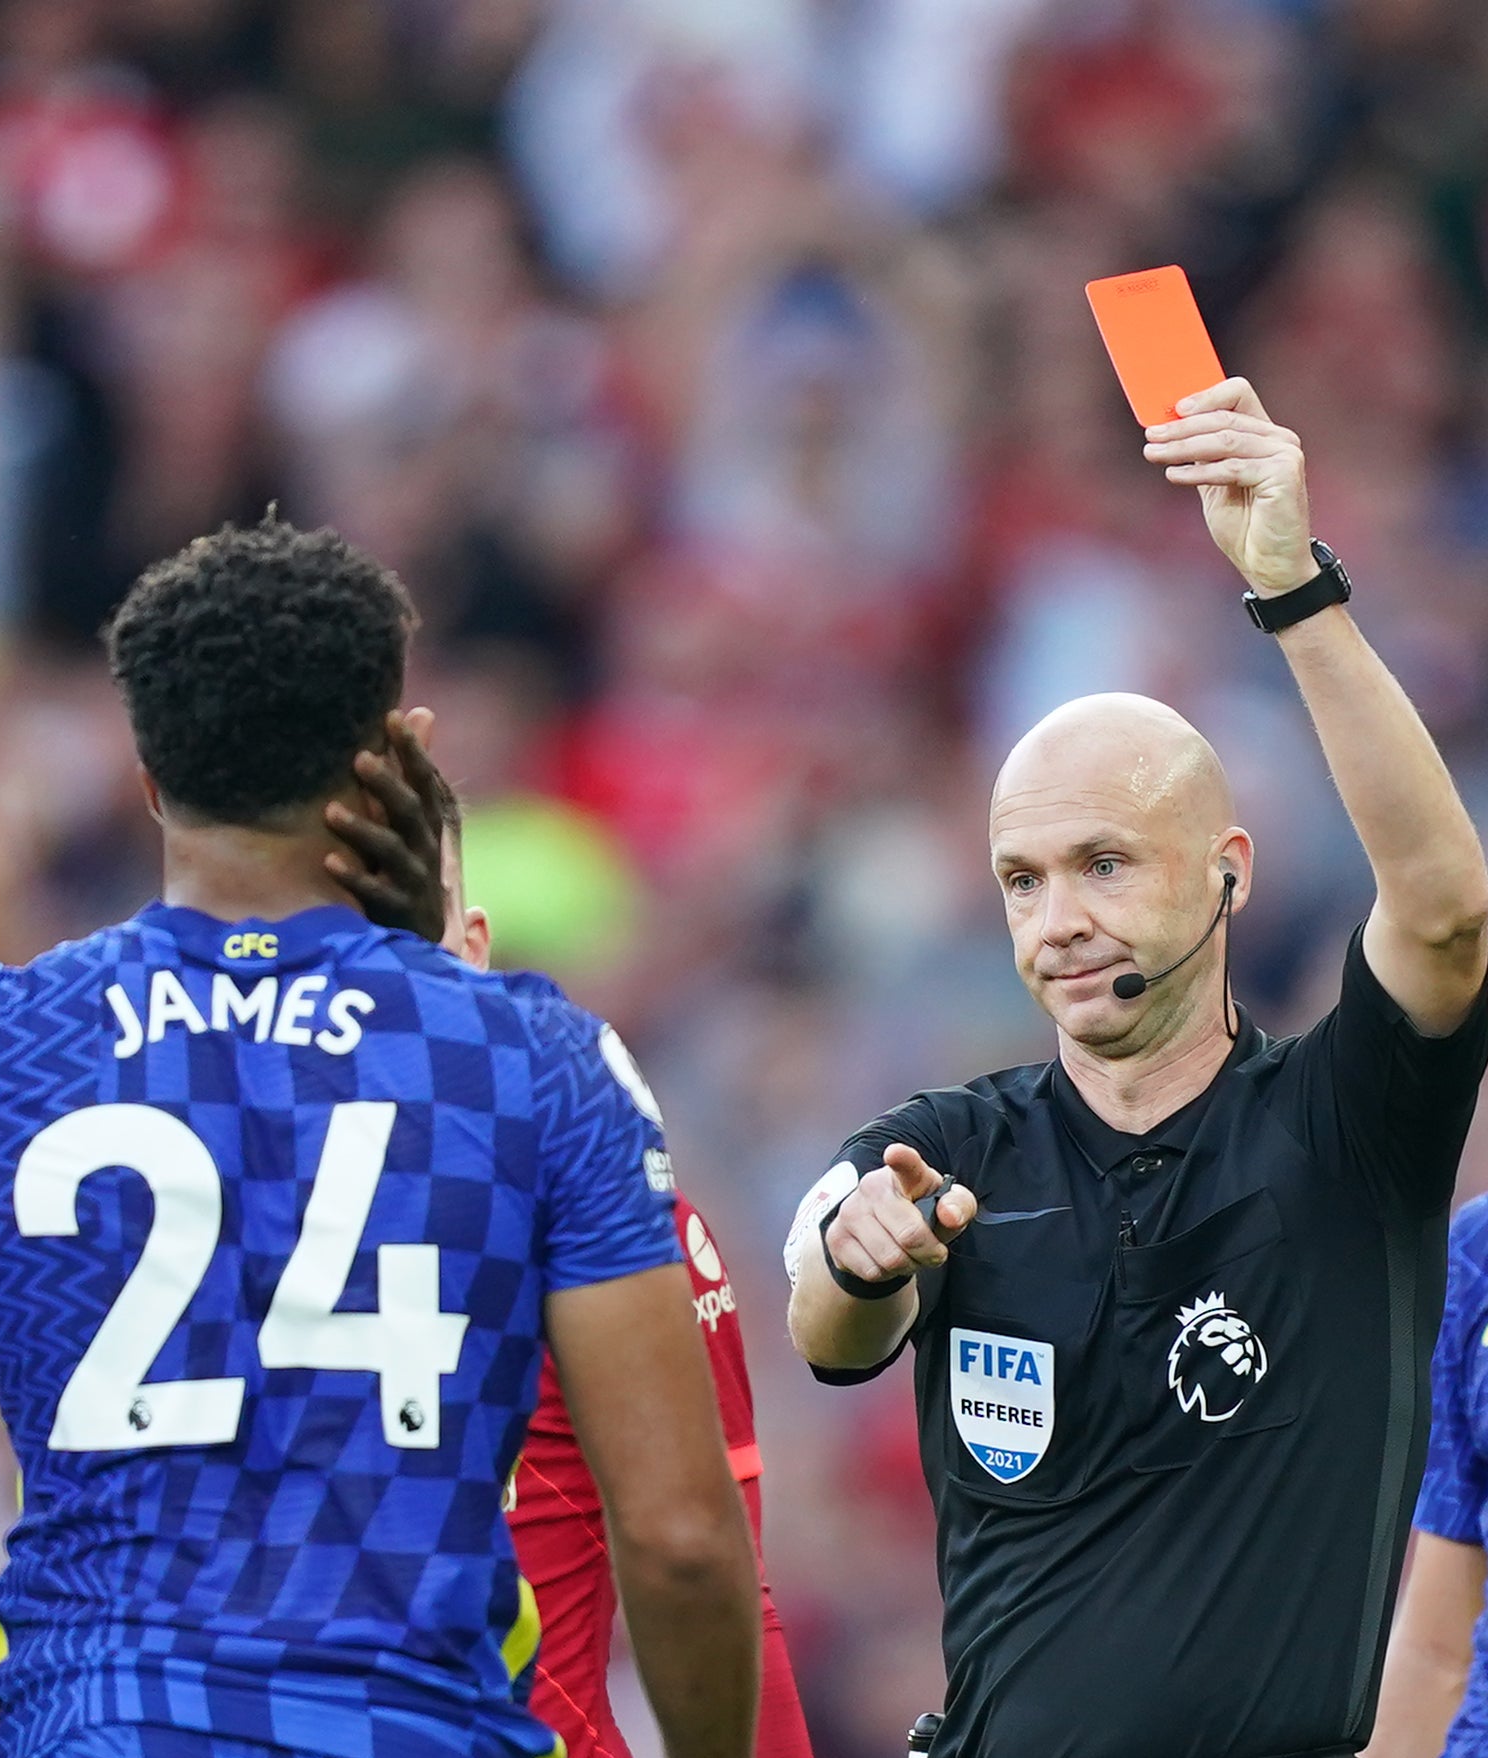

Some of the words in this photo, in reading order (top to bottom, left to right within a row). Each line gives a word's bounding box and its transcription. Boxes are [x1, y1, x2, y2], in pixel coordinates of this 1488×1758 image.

[224, 932, 279, 959] CFC
[106, 969, 376, 1059] JAMES
[13, 1101, 471, 1452] 24
[960, 1339, 1042, 1386] FIFA
[961, 1398, 1044, 1428] REFEREE
[985, 1449, 1023, 1471] 2021
